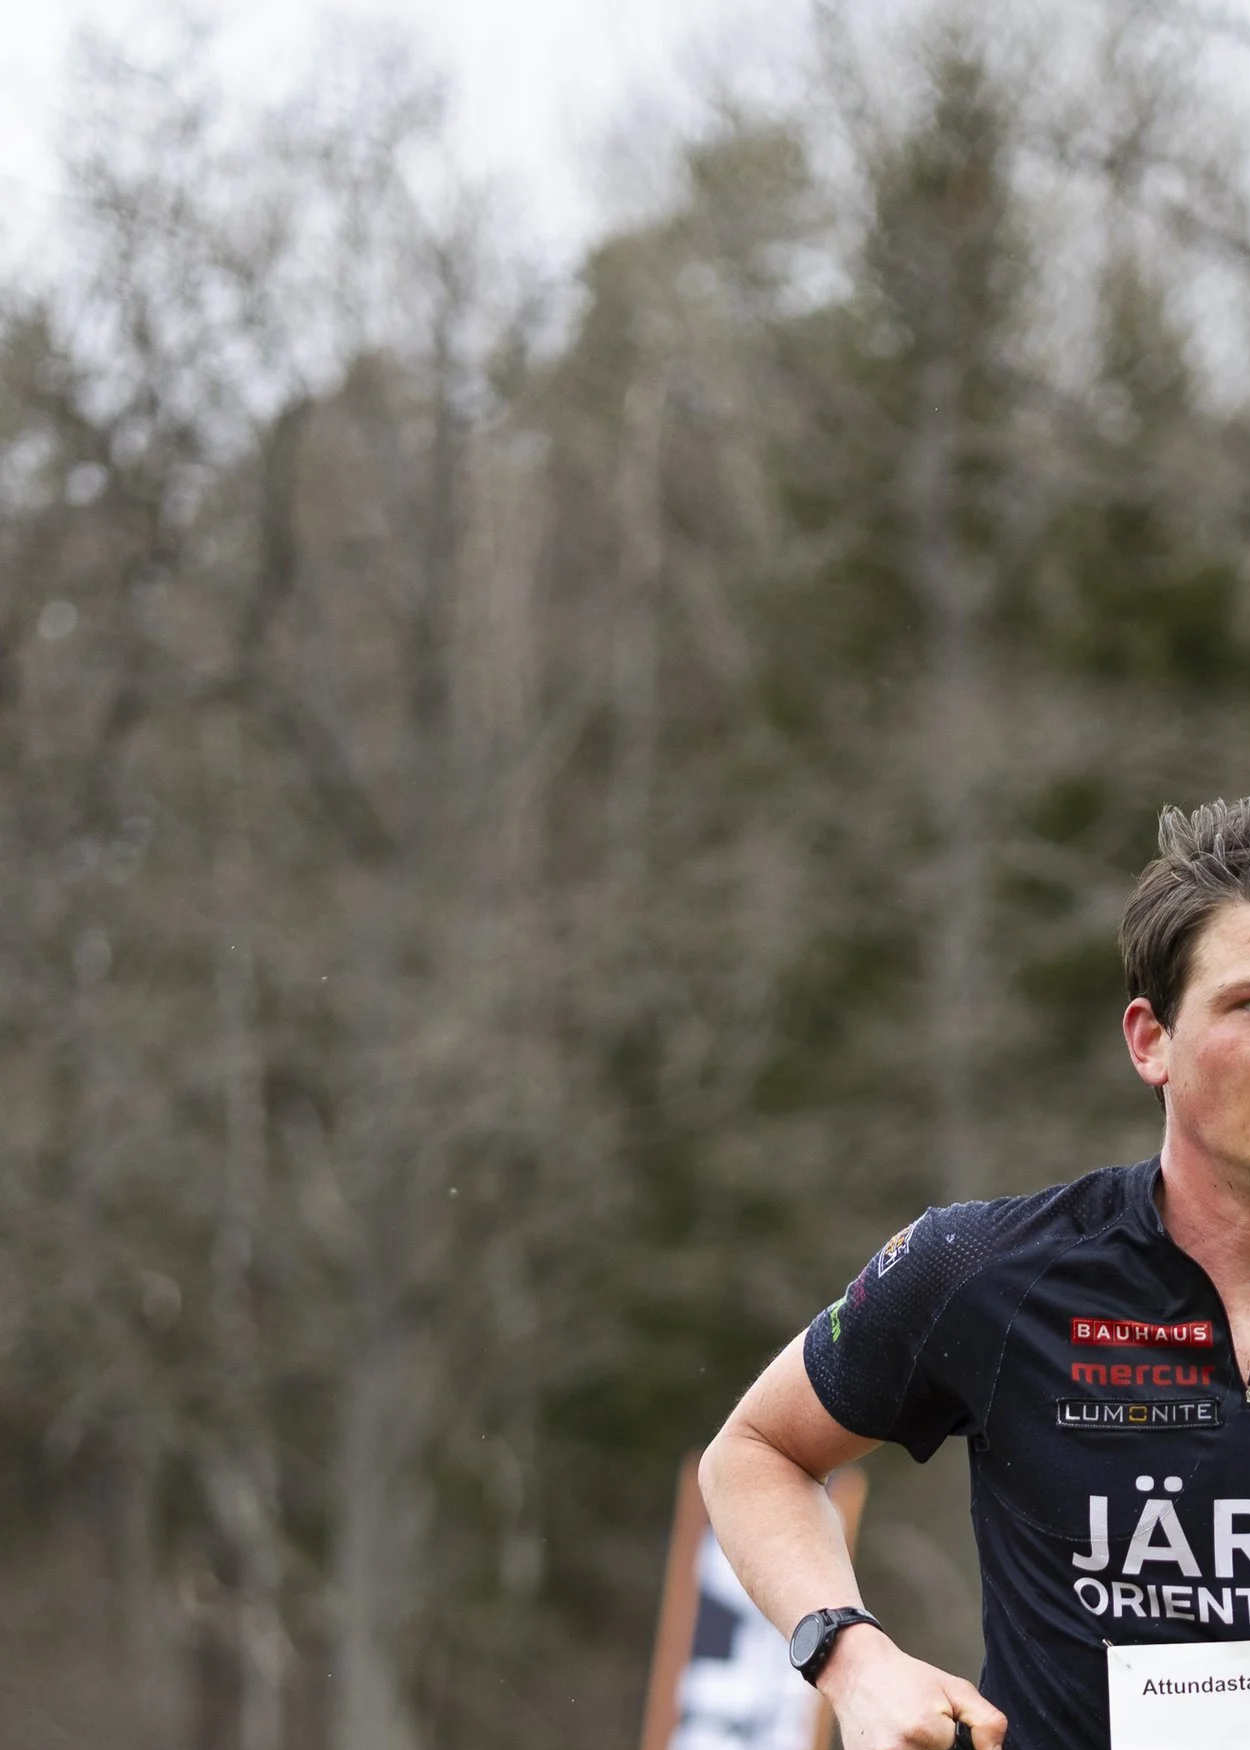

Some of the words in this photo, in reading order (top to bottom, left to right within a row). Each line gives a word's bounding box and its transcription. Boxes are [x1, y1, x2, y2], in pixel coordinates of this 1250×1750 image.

[1077, 1323, 1208, 1341] BAUHAUS
[1071, 1361, 1216, 1387] mercur
[1065, 1403, 1212, 1423] LUMONITE
